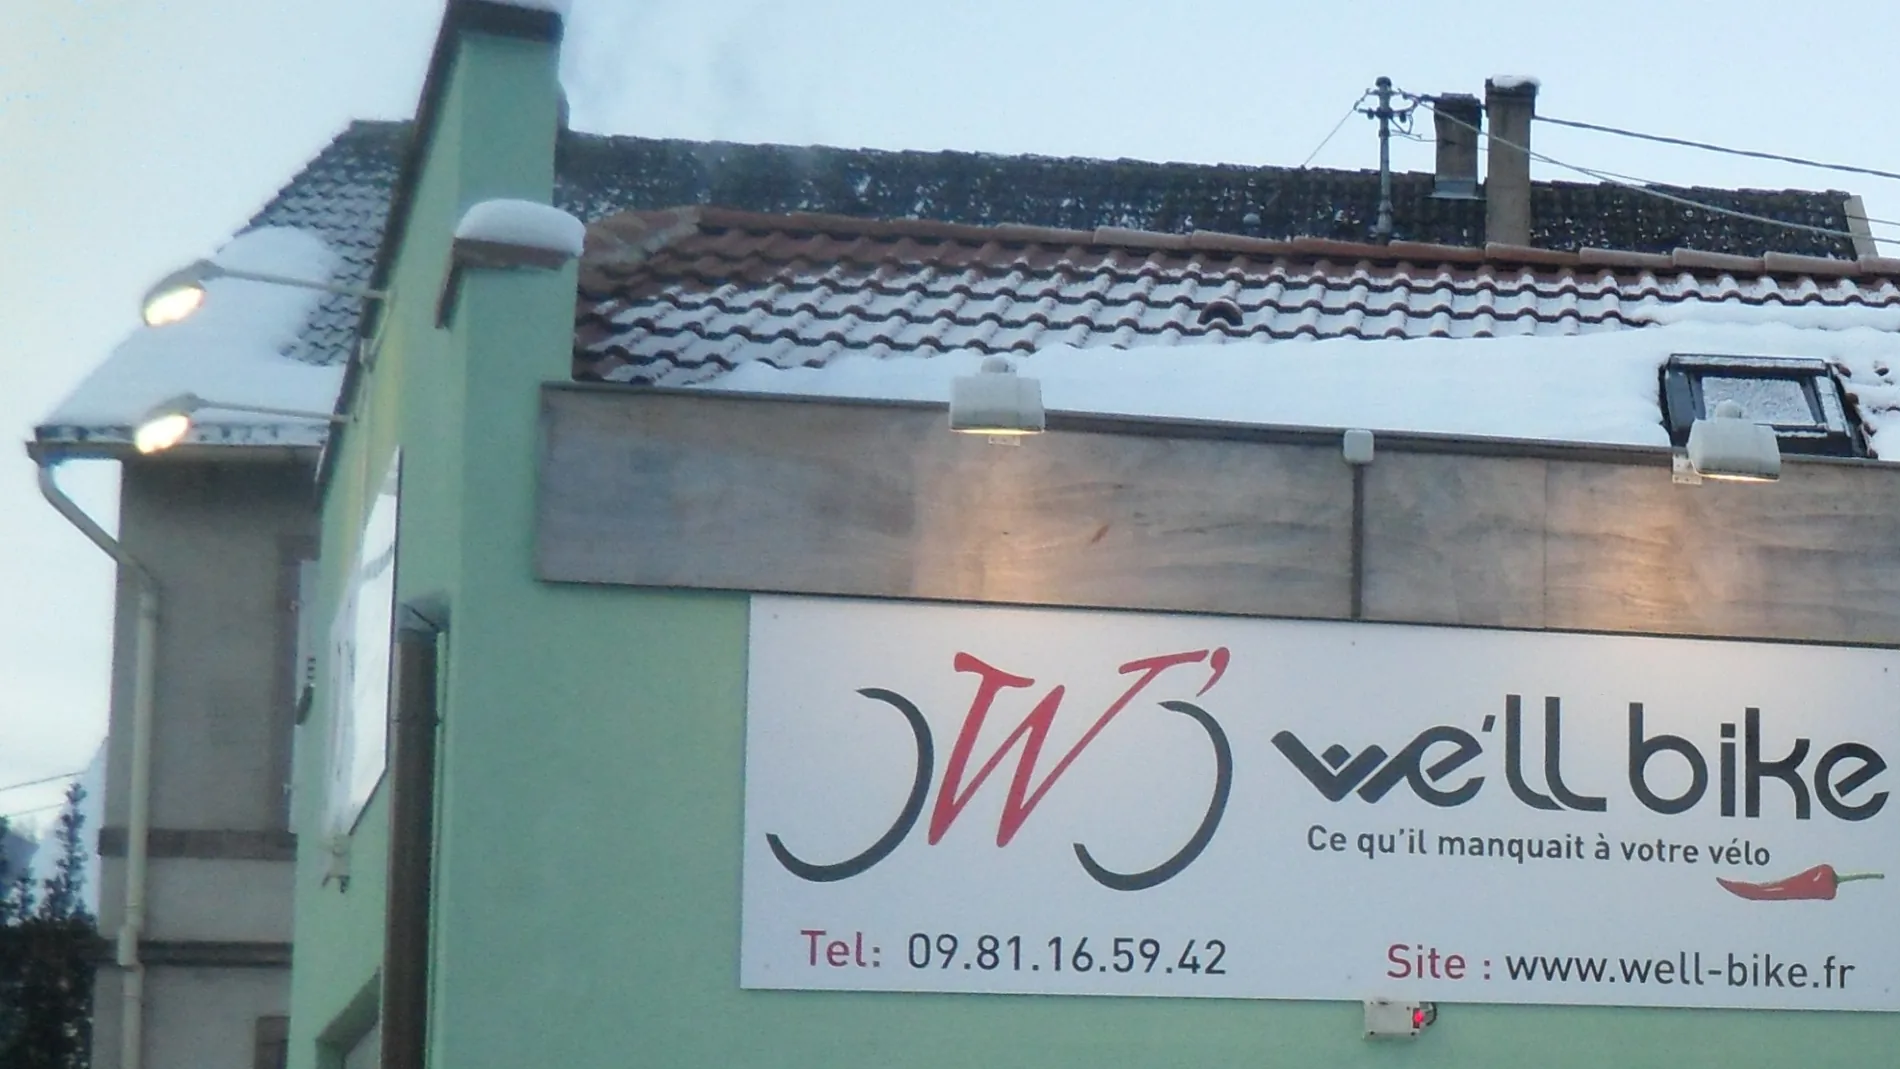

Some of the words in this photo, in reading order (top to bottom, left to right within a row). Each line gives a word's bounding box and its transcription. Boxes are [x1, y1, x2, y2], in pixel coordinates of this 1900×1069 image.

[1629, 702, 1889, 821] bike
[1307, 825, 1347, 853] Ce
[1357, 827, 1427, 863] qu'il
[1438, 831, 1585, 863] manquait
[1595, 832, 1611, 862] à
[1620, 838, 1699, 865] votre
[1708, 837, 1771, 867] vélo
[908, 933, 1227, 975] 09.81.16.59.42
[1386, 943, 1466, 980] Site
[1505, 951, 1856, 990] www.well-bike.fr
